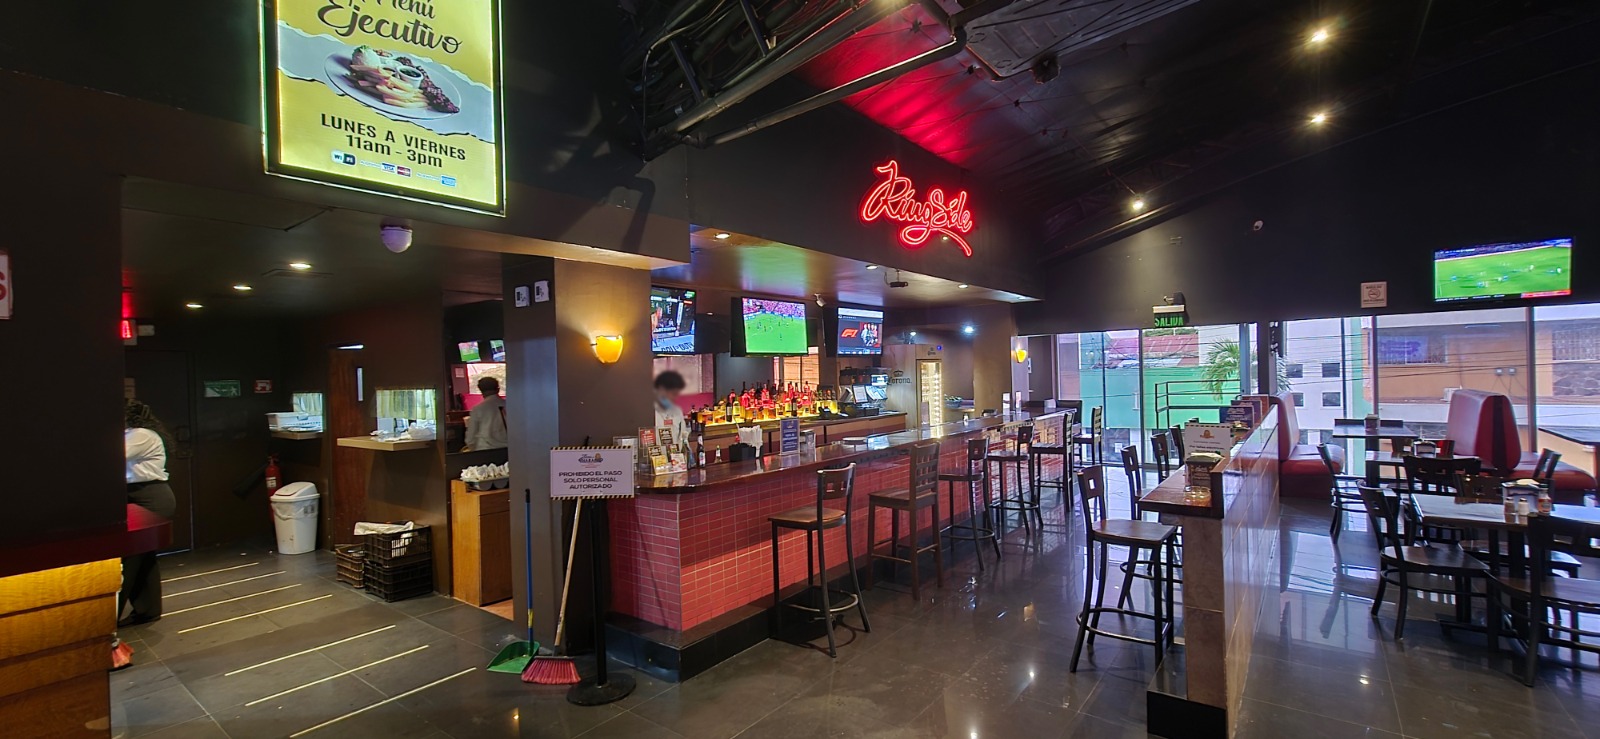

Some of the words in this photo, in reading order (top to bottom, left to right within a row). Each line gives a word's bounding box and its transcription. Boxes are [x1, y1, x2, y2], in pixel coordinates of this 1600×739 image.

[317, 0, 463, 54] Ejecutivo
[321, 113, 377, 138] LUNES
[385, 130, 396, 143] A
[403, 134, 466, 160] VIERNES
[346, 134, 391, 156] 11am
[407, 149, 442, 168] 3pm
[1154, 316, 1184, 327] SALIDA
